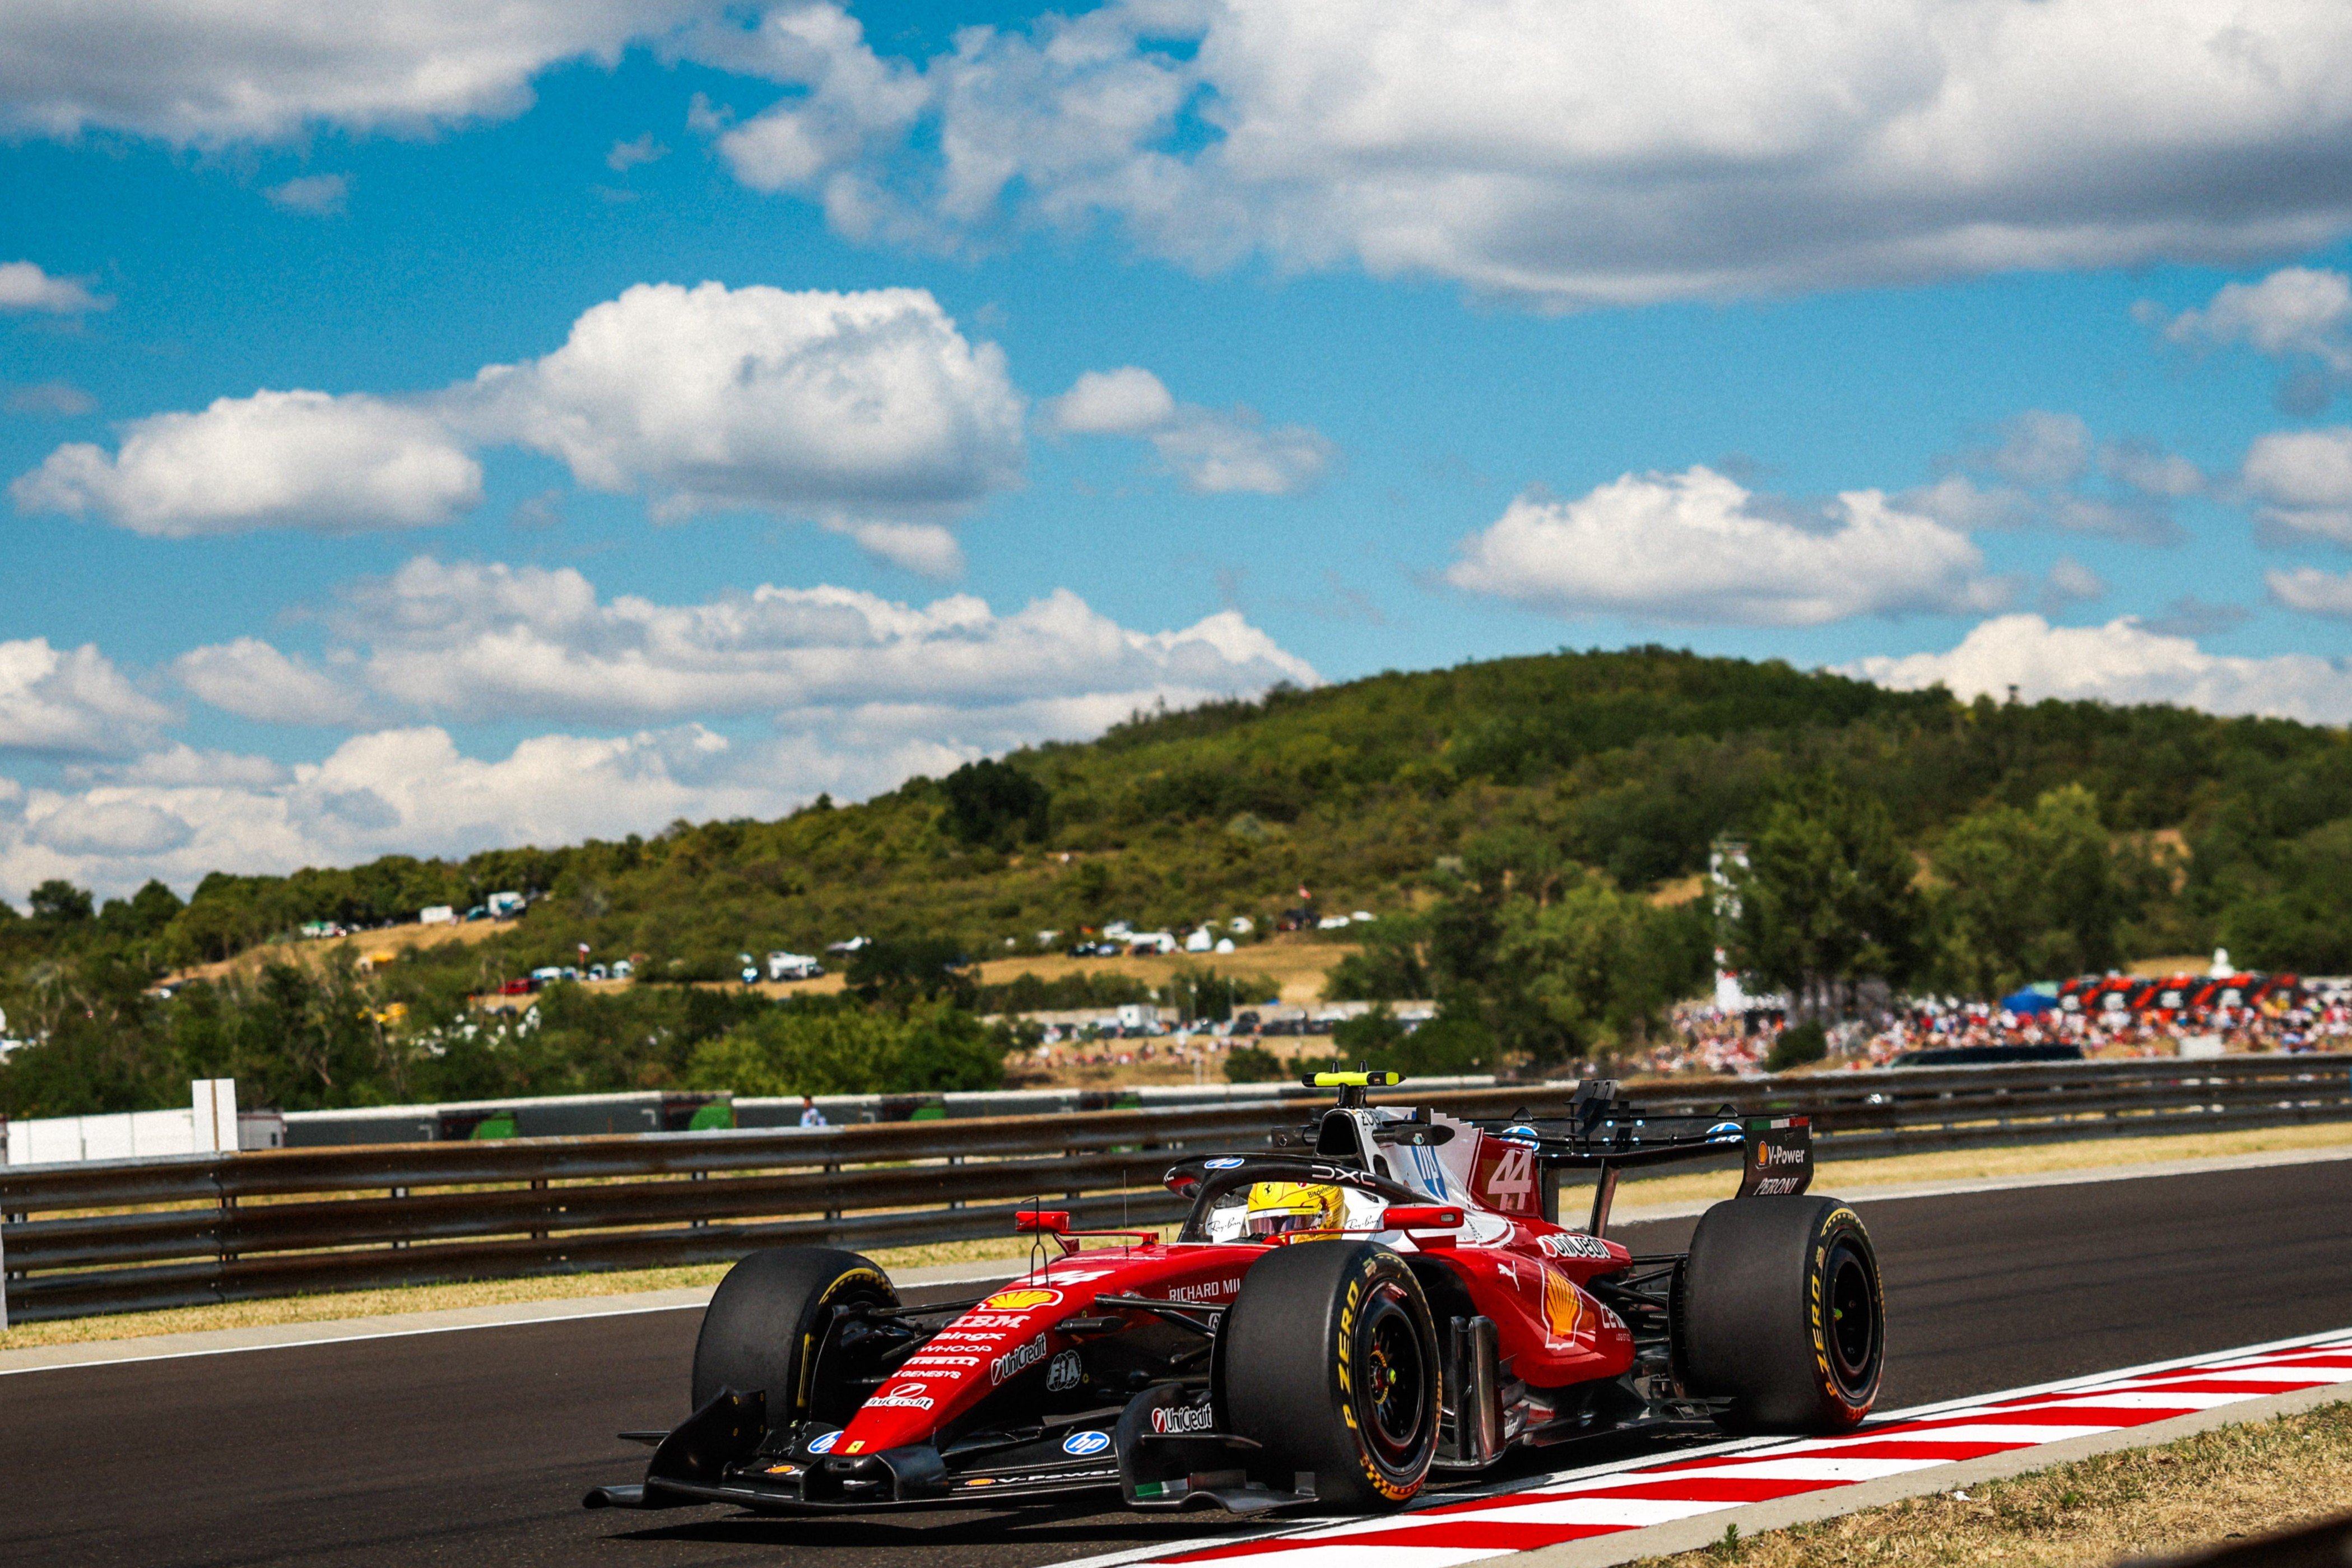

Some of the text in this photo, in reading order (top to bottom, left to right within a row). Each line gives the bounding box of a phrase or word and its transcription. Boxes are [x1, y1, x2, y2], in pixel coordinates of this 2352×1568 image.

[1768, 1146, 1805, 1165] V-Power
[1312, 1165, 1376, 1187] DXC
[1488, 1148, 1532, 1211] 44
[1753, 1177, 1799, 1196] PERONI
[1543, 1234, 1611, 1259] UniCredit
[1169, 1278, 1240, 1302] RICHARD MIL
[948, 1315, 1031, 1328] IBM
[1811, 1274, 1830, 1374] ZERO
[1338, 1279, 1359, 1395] ZERO
[1002, 1332, 1047, 1378] UniCredit
[900, 1370, 961, 1379] GENESYS
[1164, 1402, 1212, 1432] UniCredit
[1066, 1431, 1108, 1455] hp
